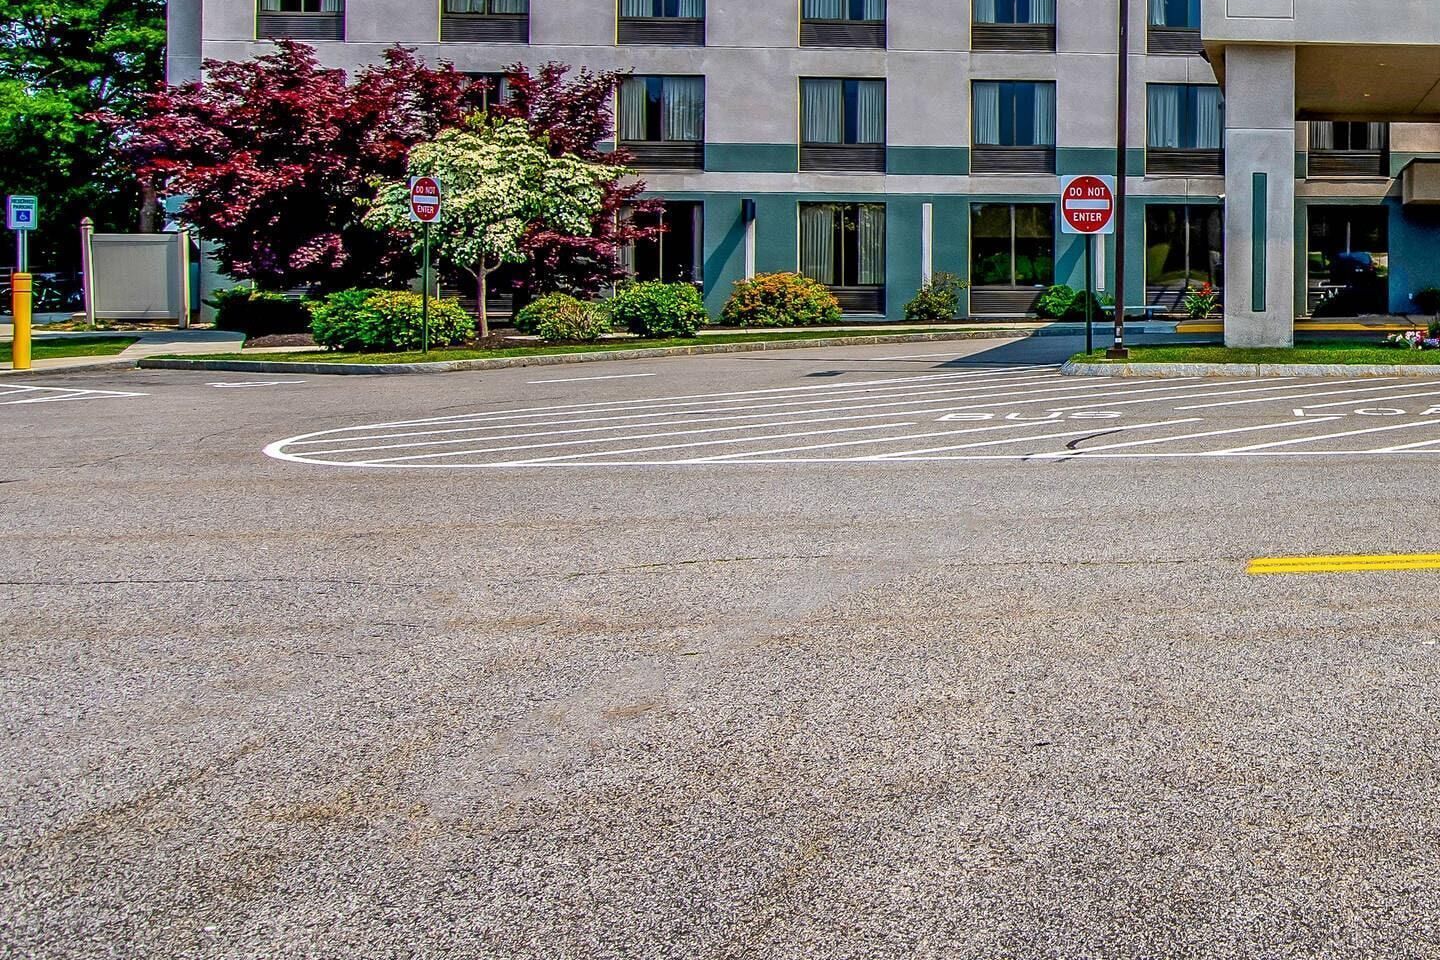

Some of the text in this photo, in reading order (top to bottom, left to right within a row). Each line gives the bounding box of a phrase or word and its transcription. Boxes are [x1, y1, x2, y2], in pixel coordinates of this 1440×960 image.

[415, 185, 436, 194] DO NOT
[1069, 187, 1106, 197] DO NOT
[417, 204, 435, 214] ENTER
[1073, 212, 1103, 222] ENTER
[933, 411, 1123, 422] BUS
